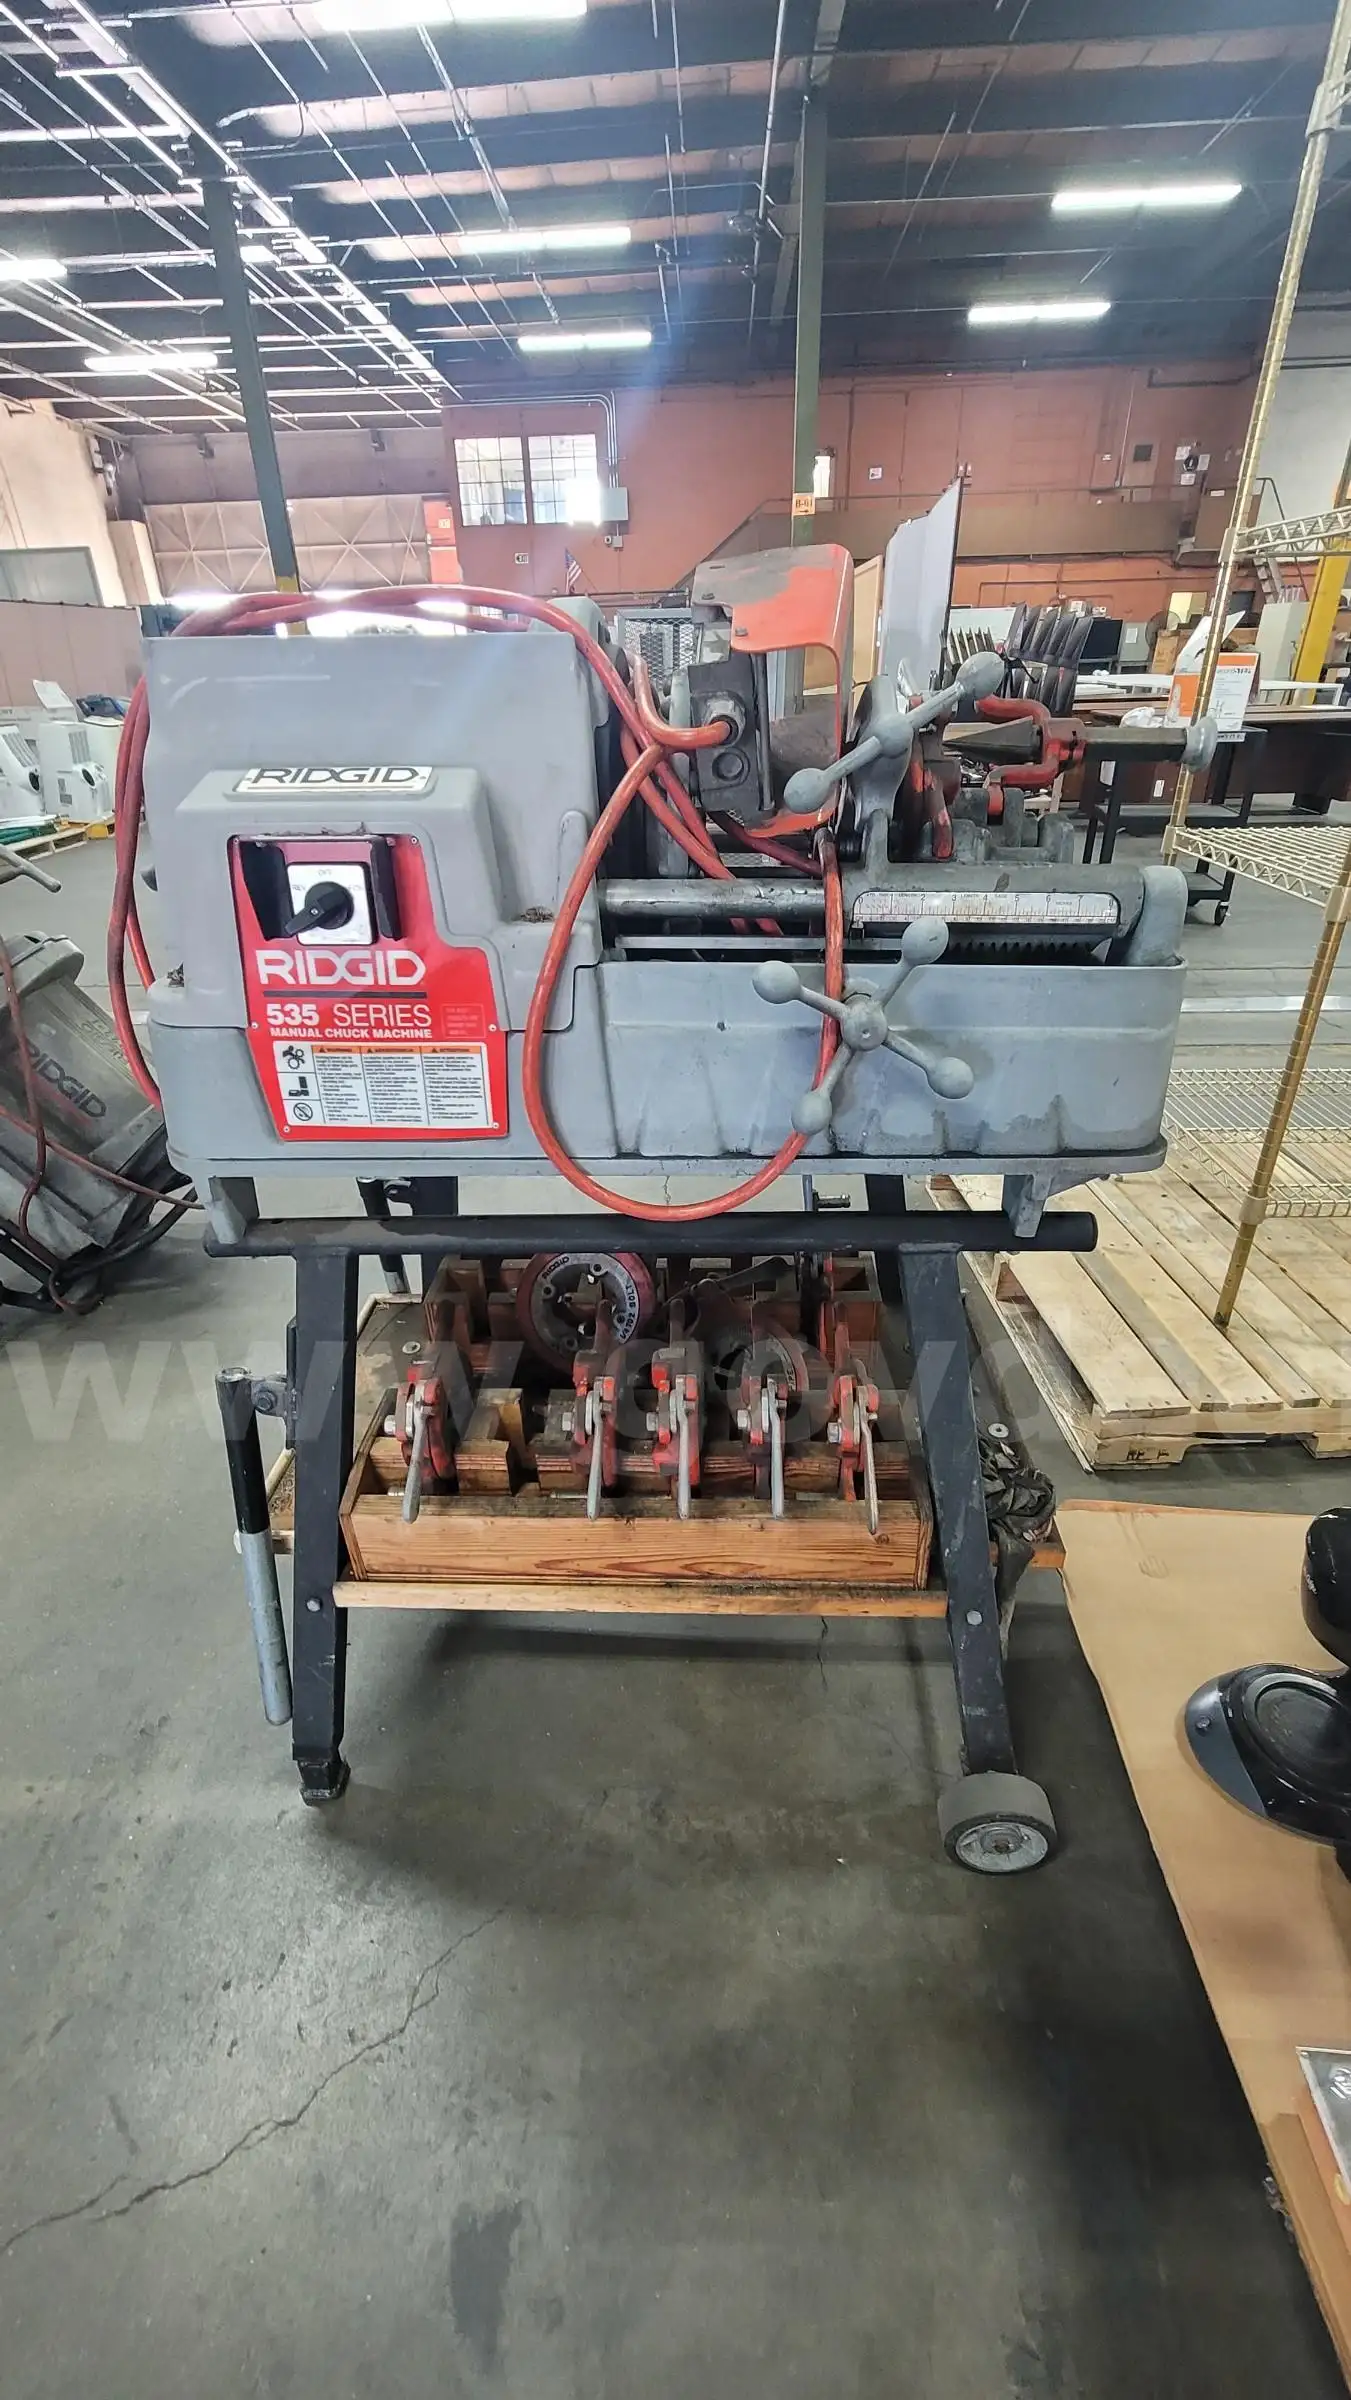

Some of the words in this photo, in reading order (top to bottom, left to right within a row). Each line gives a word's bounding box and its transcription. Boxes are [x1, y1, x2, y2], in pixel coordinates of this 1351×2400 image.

[251, 768, 420, 784] RIDGID
[255, 949, 427, 986] RIDGID
[266, 1003, 320, 1026] 535
[333, 1003, 432, 1027] SERIES
[270, 1027, 323, 1037] MANUAL
[325, 1027, 370, 1039] CHUCK
[373, 1028, 433, 1039] MACHINE
